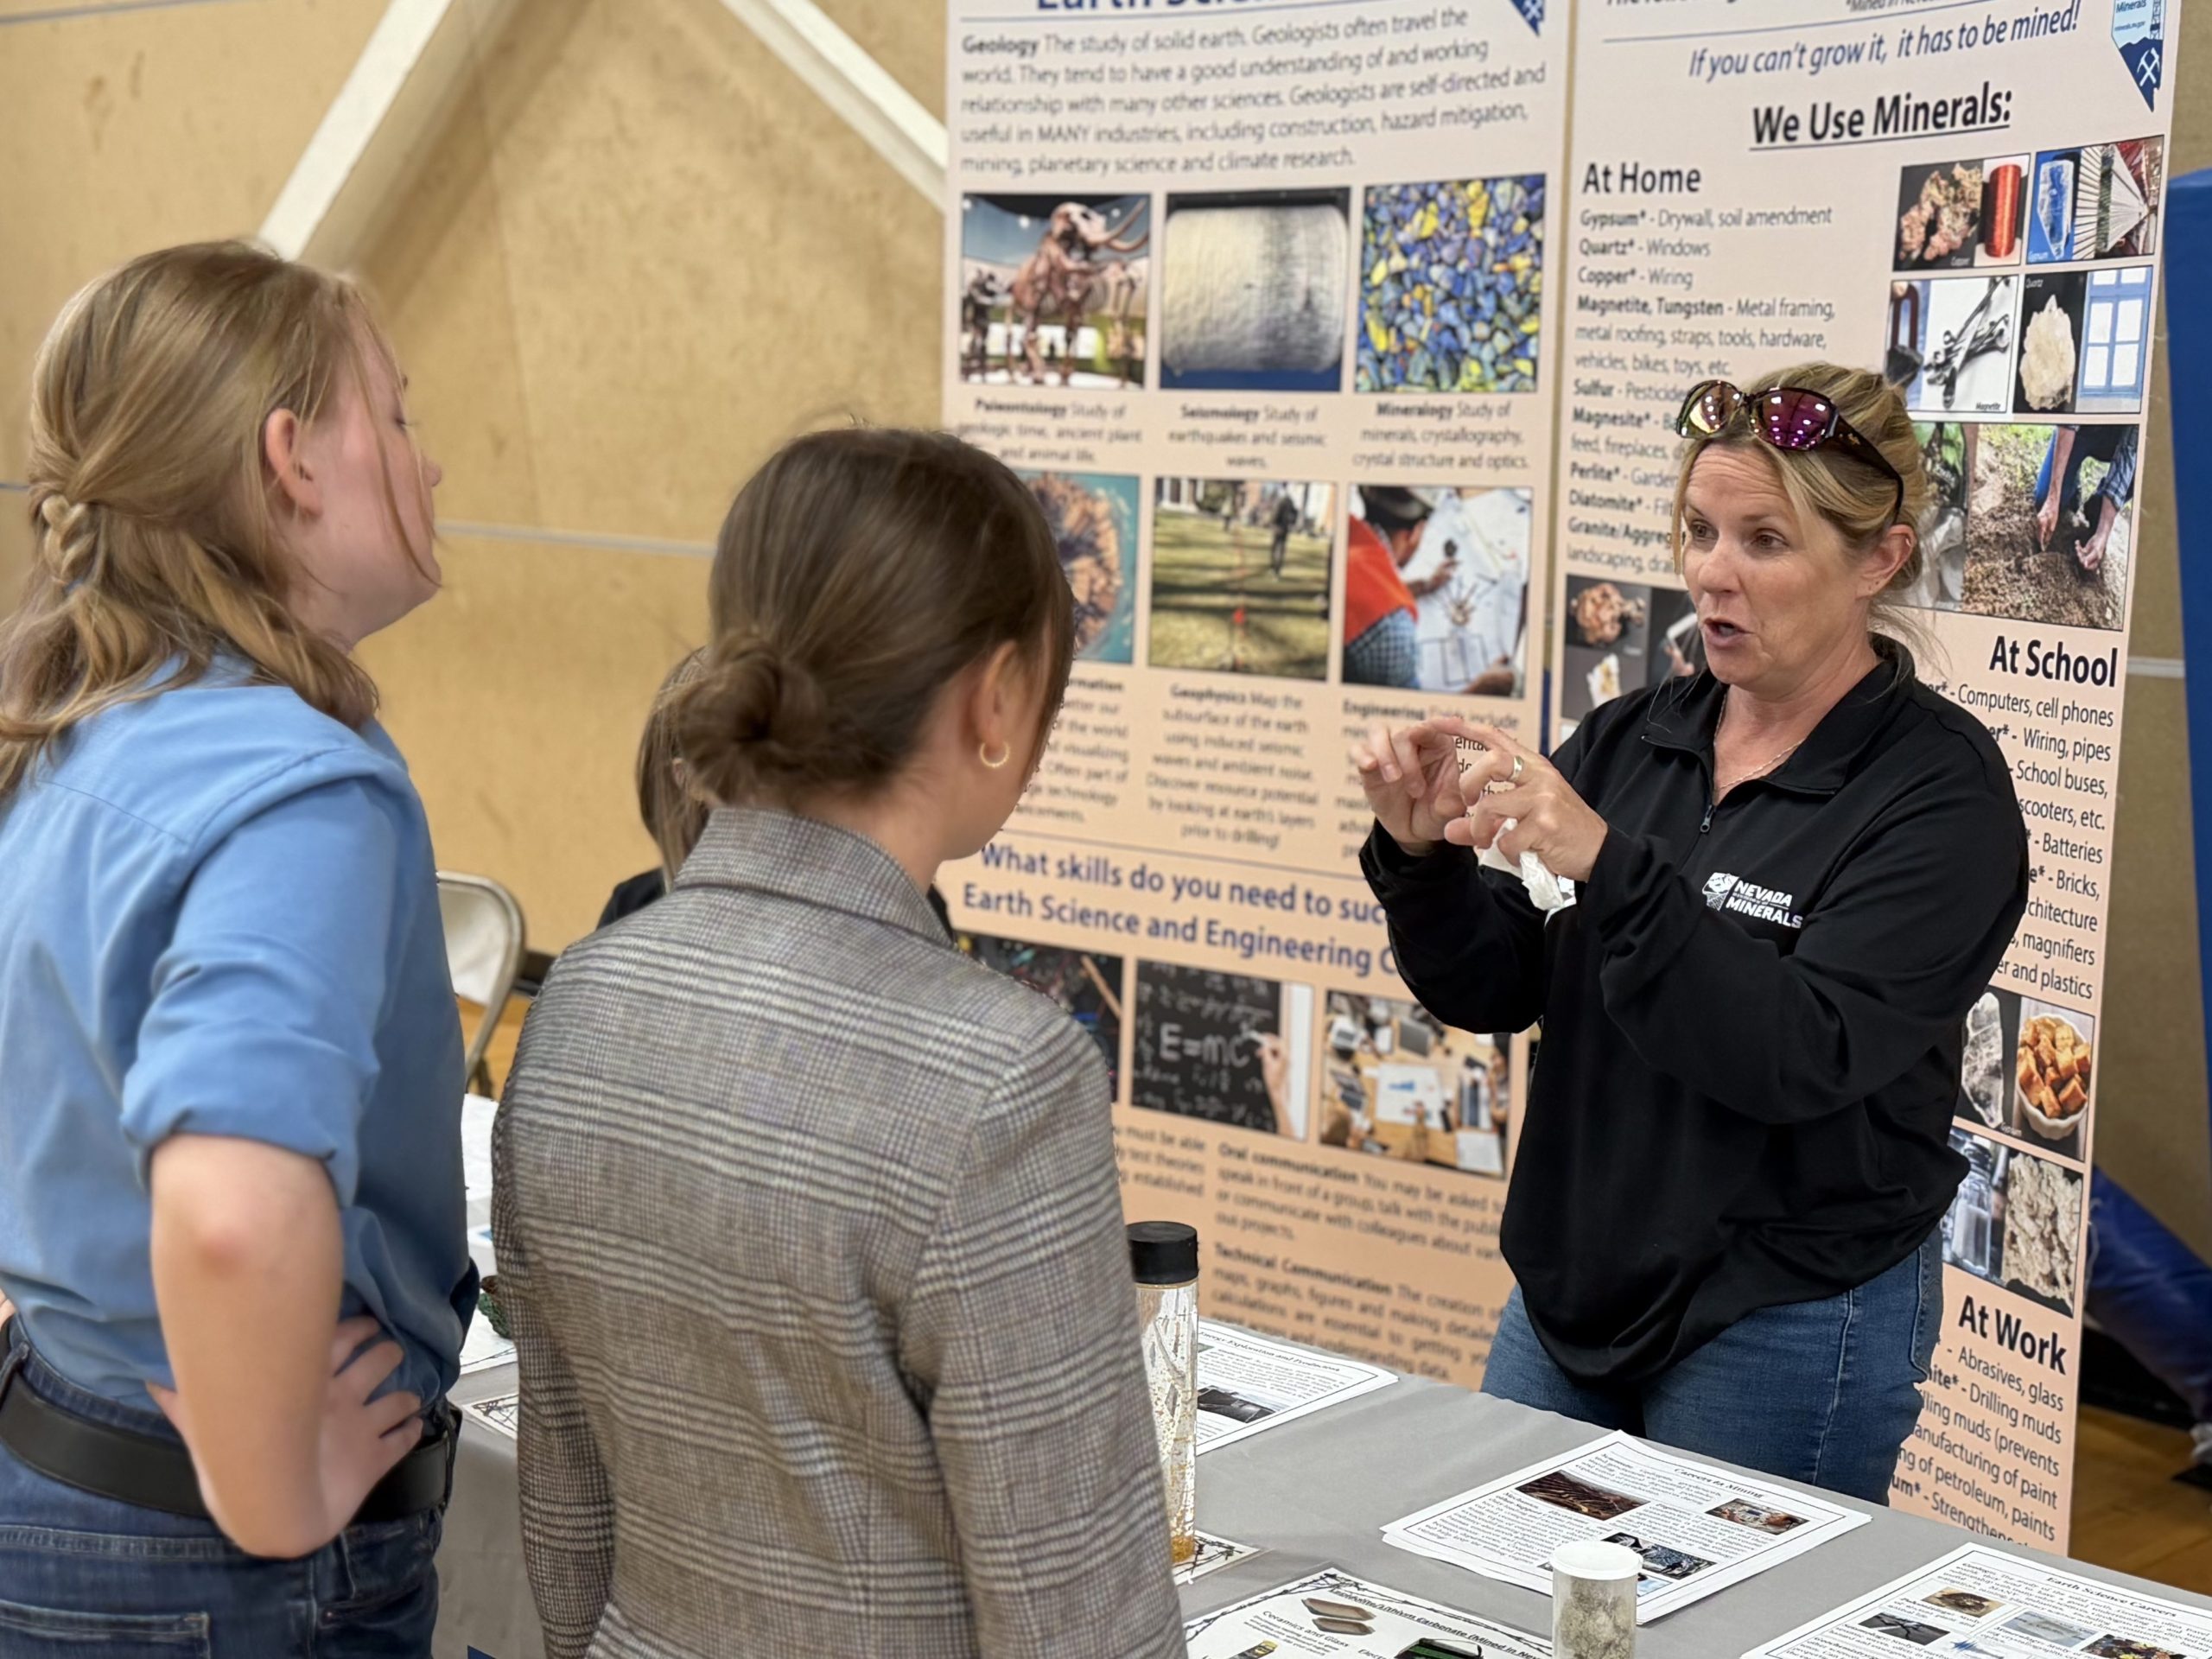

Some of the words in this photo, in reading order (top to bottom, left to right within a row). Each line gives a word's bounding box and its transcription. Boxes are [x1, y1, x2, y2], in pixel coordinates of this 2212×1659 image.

[963, 35, 1038, 57] Geology
[1045, 34, 1074, 53] The
[1080, 33, 1126, 55] study
[1132, 33, 1151, 52] of
[1154, 30, 1194, 51] solid
[1198, 28, 1245, 48] earth.
[1252, 21, 1339, 48] Geologists
[1344, 16, 1387, 37] often
[1391, 12, 1436, 35] travel
[1441, 9, 1468, 28] the
[1688, 48, 1708, 78] If
[1707, 52, 1749, 83] you
[1752, 41, 1807, 73] can't
[1809, 42, 1866, 76] grow
[1867, 32, 1887, 66] it,
[1897, 21, 1914, 57] it
[1916, 24, 1953, 56] has
[1956, 22, 1979, 50] to
[1982, 14, 2008, 46] be
[2010, 3, 2081, 42] mined!
[962, 66, 1012, 85] world.
[1019, 65, 1058, 86] They
[1065, 63, 1104, 83] tend
[1109, 66, 1126, 82] to
[1131, 61, 1172, 81] have
[1176, 65, 1186, 80] a
[1192, 60, 1236, 85] good
[1241, 47, 1362, 79] understanding
[1366, 47, 1384, 68] of
[1387, 43, 1419, 65] and
[1422, 39, 1488, 62] working
[962, 93, 1063, 116] relationship
[1068, 93, 1104, 112] with
[1109, 96, 1156, 115] many
[1161, 92, 1207, 112] other
[1212, 87, 1285, 110] sciences.
[1289, 82, 1376, 107] Geologists
[1380, 81, 1406, 99] are
[1409, 67, 1510, 97] self-directed
[1514, 62, 1546, 85] and
[961, 123, 1012, 143] useful
[1016, 124, 1033, 143] in
[1037, 124, 1090, 143] MANY
[1093, 122, 1182, 144] industries,
[1185, 116, 1264, 142] including
[1268, 111, 1377, 137] construction,
[1381, 107, 1437, 131] hazard
[1440, 100, 1529, 129] mitigation,
[1751, 105, 1800, 144] We
[1808, 102, 1866, 141] Use
[1872, 80, 2013, 136] Minerals:
[961, 156, 1024, 176] mining,
[1028, 154, 1109, 175] planetary
[1115, 154, 1176, 172] science
[1180, 152, 1214, 171] and
[1217, 149, 1279, 170] climate
[1282, 147, 1355, 168] research.
[1582, 162, 1612, 194] At
[1619, 162, 1702, 194] Home
[1657, 207, 1715, 231] Drywall,
[1718, 208, 1743, 227] soil
[1745, 205, 1833, 226] amendment
[1646, 238, 1712, 257] Windows
[1648, 267, 1694, 290] Wiring
[1576, 294, 1653, 317] Magnetite,
[1656, 296, 1724, 320] Tungsten
[1736, 296, 1776, 318] Metal
[1778, 297, 1835, 322] framing,
[1575, 323, 1612, 342] metal
[1615, 324, 1667, 346] roofing,
[1670, 327, 1714, 347] straps,
[1718, 327, 1756, 348] tools,
[1759, 329, 1827, 351] hardware,
[1574, 353, 1629, 372] vehicles,
[1632, 354, 1670, 374] bikes,
[1674, 358, 1704, 378] toys,
[1707, 359, 1732, 377] etc.
[1573, 378, 1614, 397] Sulfur
[1376, 401, 1453, 422] Mineralogy
[1457, 401, 1494, 419] Study
[1497, 401, 1513, 417] of
[1988, 634, 2020, 675] At
[2024, 639, 2119, 688] School
[1958, 683, 2033, 718] Computers,
[2036, 696, 2058, 719] cell
[2062, 699, 2114, 728] phones
[2023, 726, 2069, 760] Wiring,
[2072, 735, 2112, 763] pipes
[2016, 759, 2062, 788] School
[2063, 766, 2108, 799] buses,
[2018, 797, 2078, 828] scooters,
[2080, 808, 2106, 830] etc.
[2042, 832, 2104, 864] Batteries
[982, 842, 1049, 876] What
[1055, 852, 1122, 887] skills
[1129, 862, 1163, 893] do
[1171, 873, 1222, 902] you
[1229, 878, 1295, 912] need
[1304, 889, 1332, 918] to
[1733, 880, 1793, 907] NEVADA
[2056, 868, 2101, 902] Bricks,
[963, 881, 1033, 918] Earth
[1040, 893, 1140, 937] Science
[1146, 912, 1198, 944] and
[1205, 918, 1373, 977] Engineering
[1725, 896, 1804, 929] MINERALS
[2027, 895, 2098, 932] chitecture
[2022, 932, 2096, 967] magnifiers
[2012, 961, 2039, 984] and
[2040, 968, 2094, 1001] plastics
[1957, 1294, 1990, 1339] At
[1994, 1307, 2067, 1376] Work
[1957, 1345, 2026, 1397] Abrasives,
[2027, 1381, 2064, 1413] glass
[1968, 1382, 2020, 1428] Drilling
[2022, 1412, 2063, 1446] muds
[1953, 1410, 1993, 1443] muds
[1993, 1427, 2061, 1478] (prevents
[1913, 1423, 2001, 1484] anufacturing
[2003, 1466, 2020, 1490] of
[2019, 1475, 2058, 1511] paint
[1918, 1453, 1934, 1476] of
[1934, 1465, 2009, 1521] petroleum,
[2012, 1503, 2056, 1542] paints
[2046, 1576, 2081, 1592] Earth
[2082, 1586, 2128, 1607] Science
[2129, 1599, 2177, 1618] Careers
